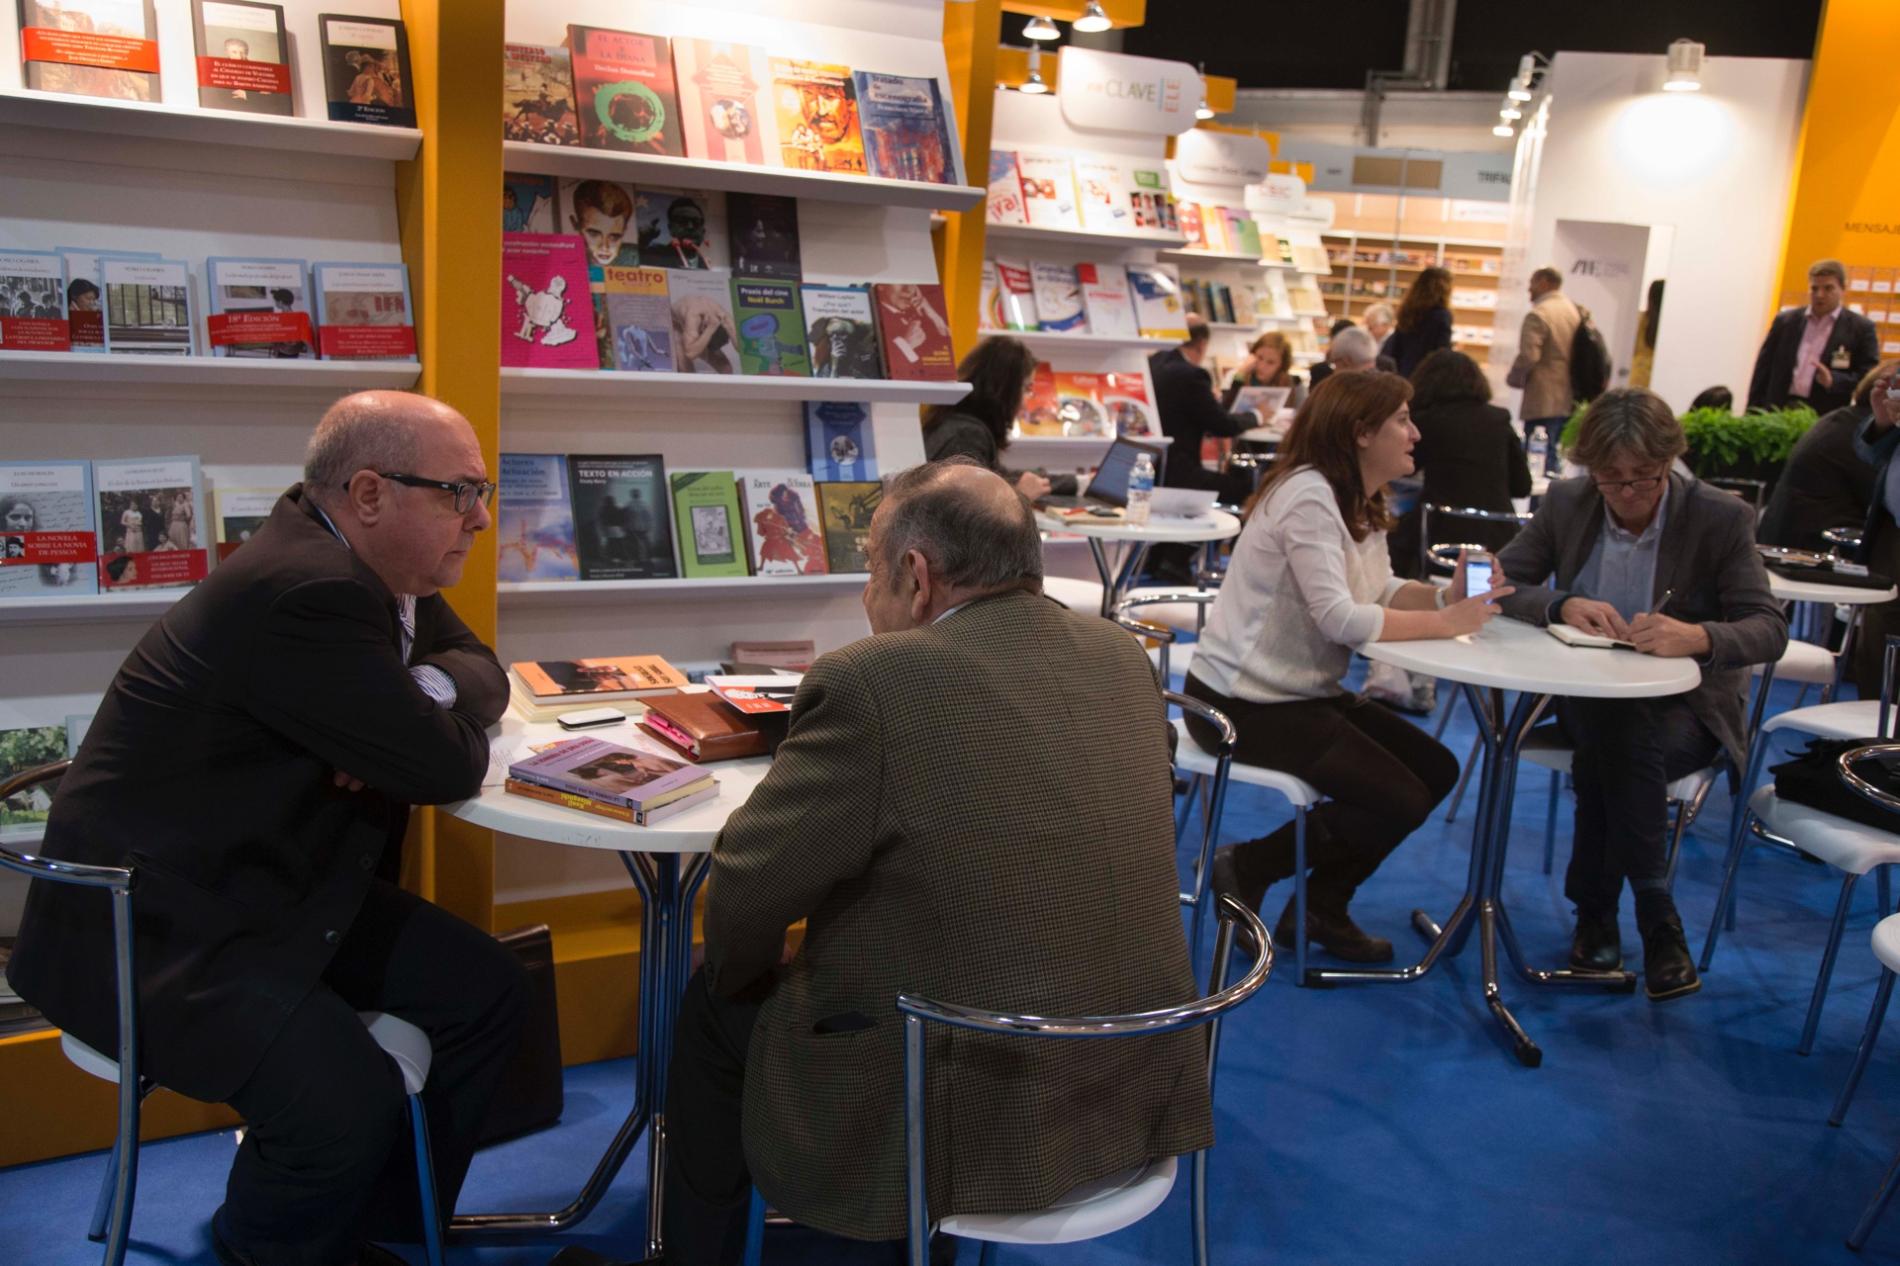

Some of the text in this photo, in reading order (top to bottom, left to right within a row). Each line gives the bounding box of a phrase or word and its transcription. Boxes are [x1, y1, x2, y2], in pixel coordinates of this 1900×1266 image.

[613, 35, 644, 46] ACTOR
[607, 268, 664, 283] teatro
[740, 287, 788, 297] Praxis del cine
[578, 469, 653, 478] TEXTO EN ACCIÓN
[49, 534, 79, 542] NOVELA
